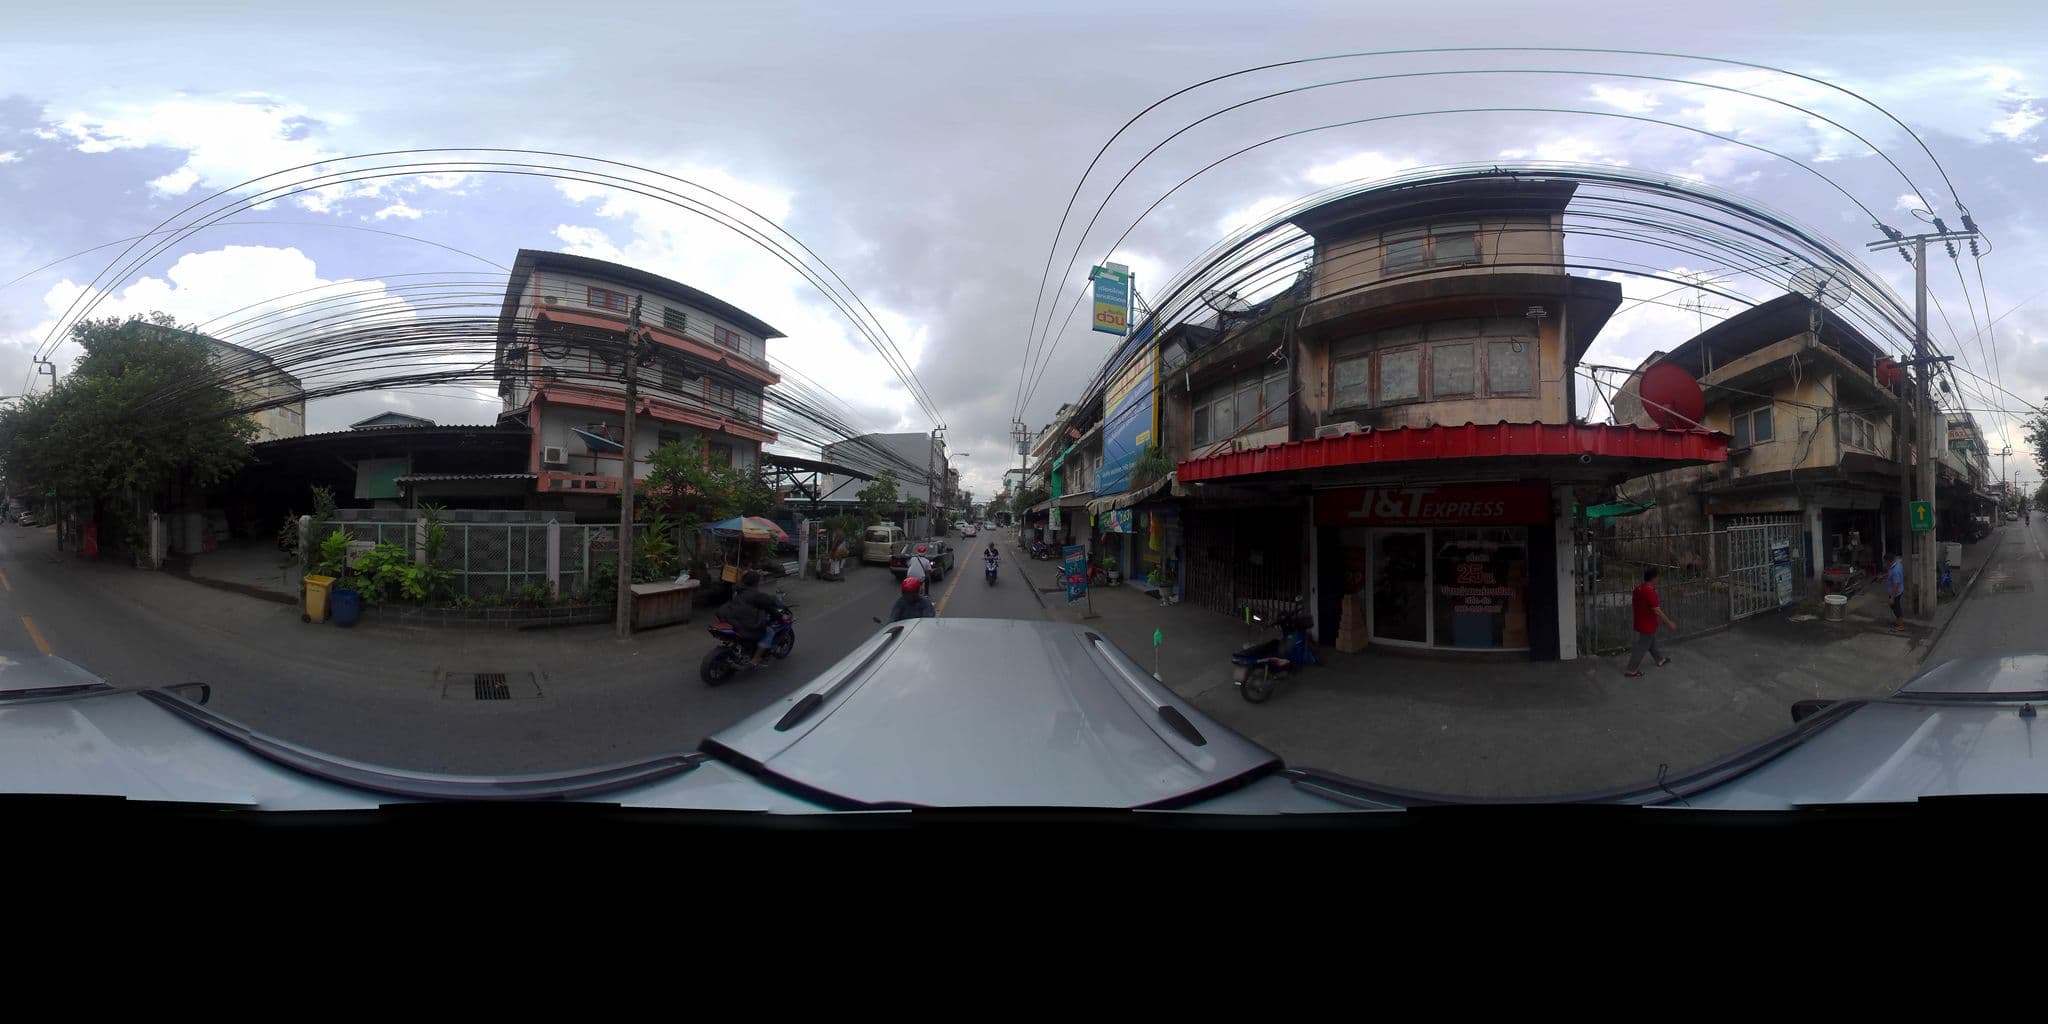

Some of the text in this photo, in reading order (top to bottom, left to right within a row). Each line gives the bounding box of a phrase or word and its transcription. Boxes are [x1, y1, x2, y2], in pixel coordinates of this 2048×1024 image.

[1347, 488, 1504, 518] J&T EXPRESS
[1457, 563, 1484, 584] 25
